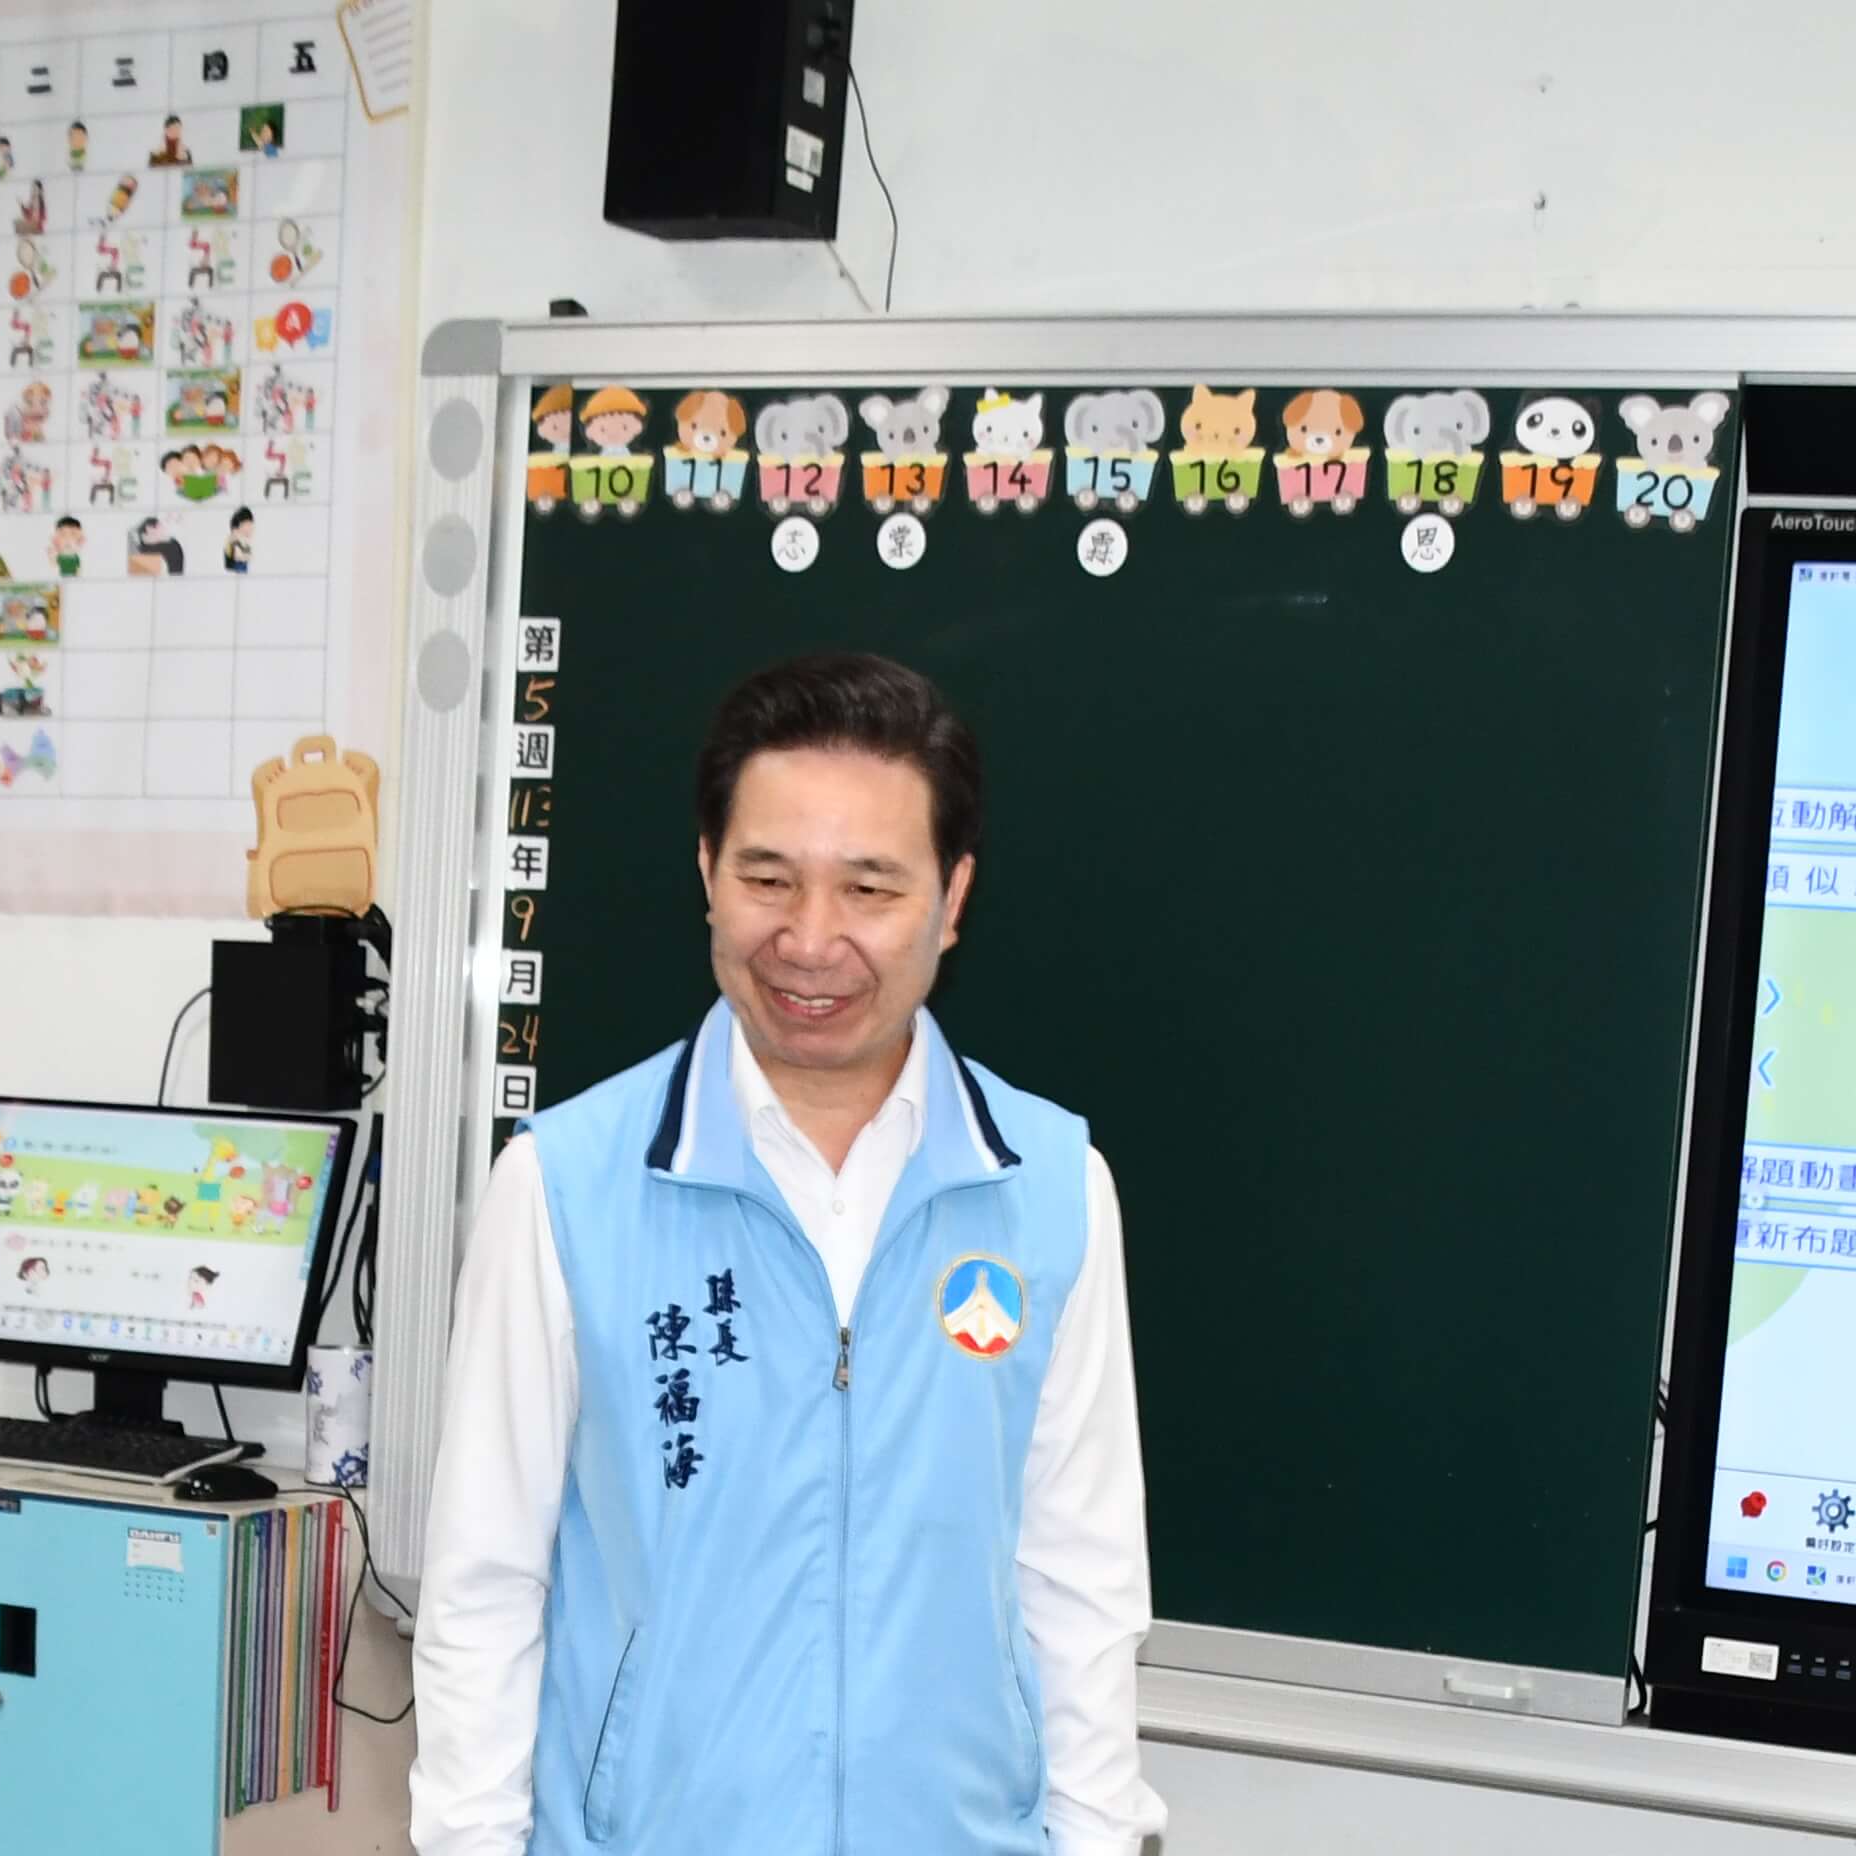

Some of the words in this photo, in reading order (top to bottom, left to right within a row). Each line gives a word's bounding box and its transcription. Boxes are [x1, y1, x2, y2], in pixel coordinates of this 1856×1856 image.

[27, 67, 52, 94] 二
[111, 57, 137, 87] 三
[202, 50, 229, 82] 四
[289, 40, 317, 74] 五
[587, 466, 634, 494] 10
[683, 459, 723, 490] 11
[776, 464, 822, 495] 12
[882, 463, 926, 495] 13
[984, 462, 1032, 494] 14
[1089, 459, 1132, 490] 15
[1196, 463, 1241, 494] 16
[1302, 462, 1346, 494] 17
[1407, 460, 1458, 495] 18
[1521, 464, 1574, 495] 19
[1635, 472, 1693, 510] 20
[704, 1268, 750, 1367] 縣長
[646, 1304, 705, 1490] 陳福海
